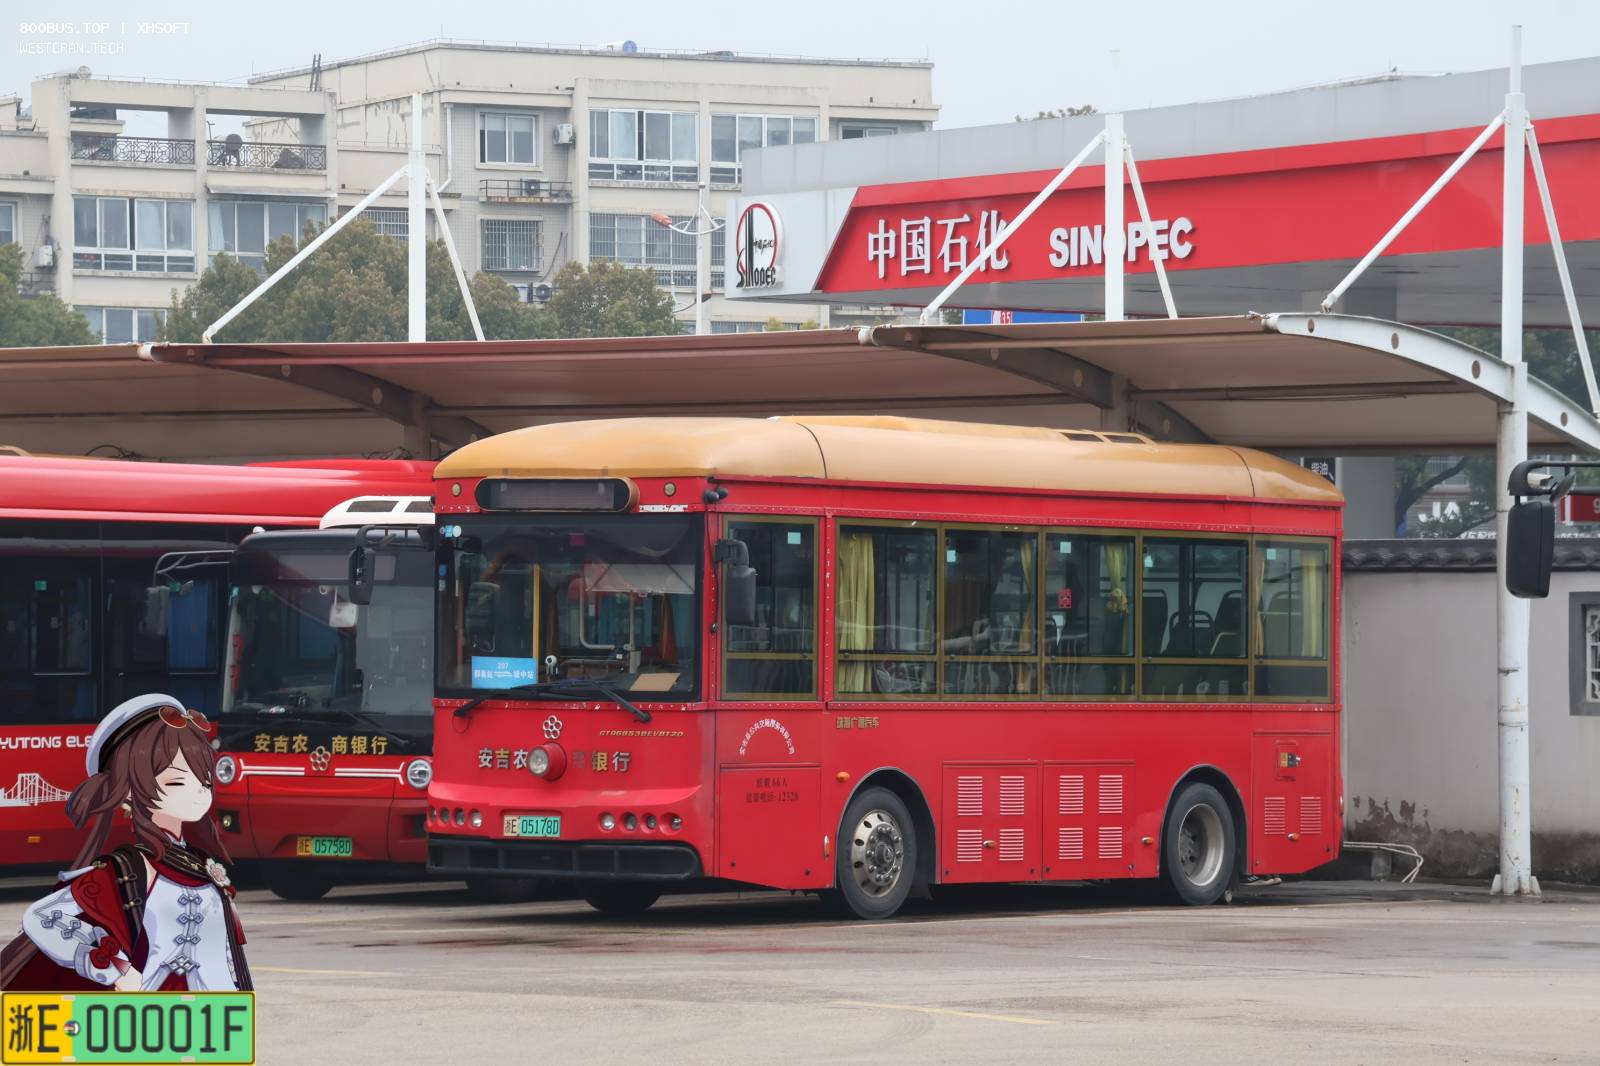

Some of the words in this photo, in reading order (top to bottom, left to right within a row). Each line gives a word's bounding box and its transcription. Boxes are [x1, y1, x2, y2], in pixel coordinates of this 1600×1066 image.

[868, 209, 1009, 279] 中国石化
[1048, 217, 1193, 268] SINPEC
[0, 735, 61, 750] YUTONG
[254, 733, 308, 752] 安吉农
[331, 735, 388, 754] 商银行
[478, 747, 528, 769] 安吉农
[521, 818, 559, 835] 05178D
[314, 839, 351, 854] 05758D
